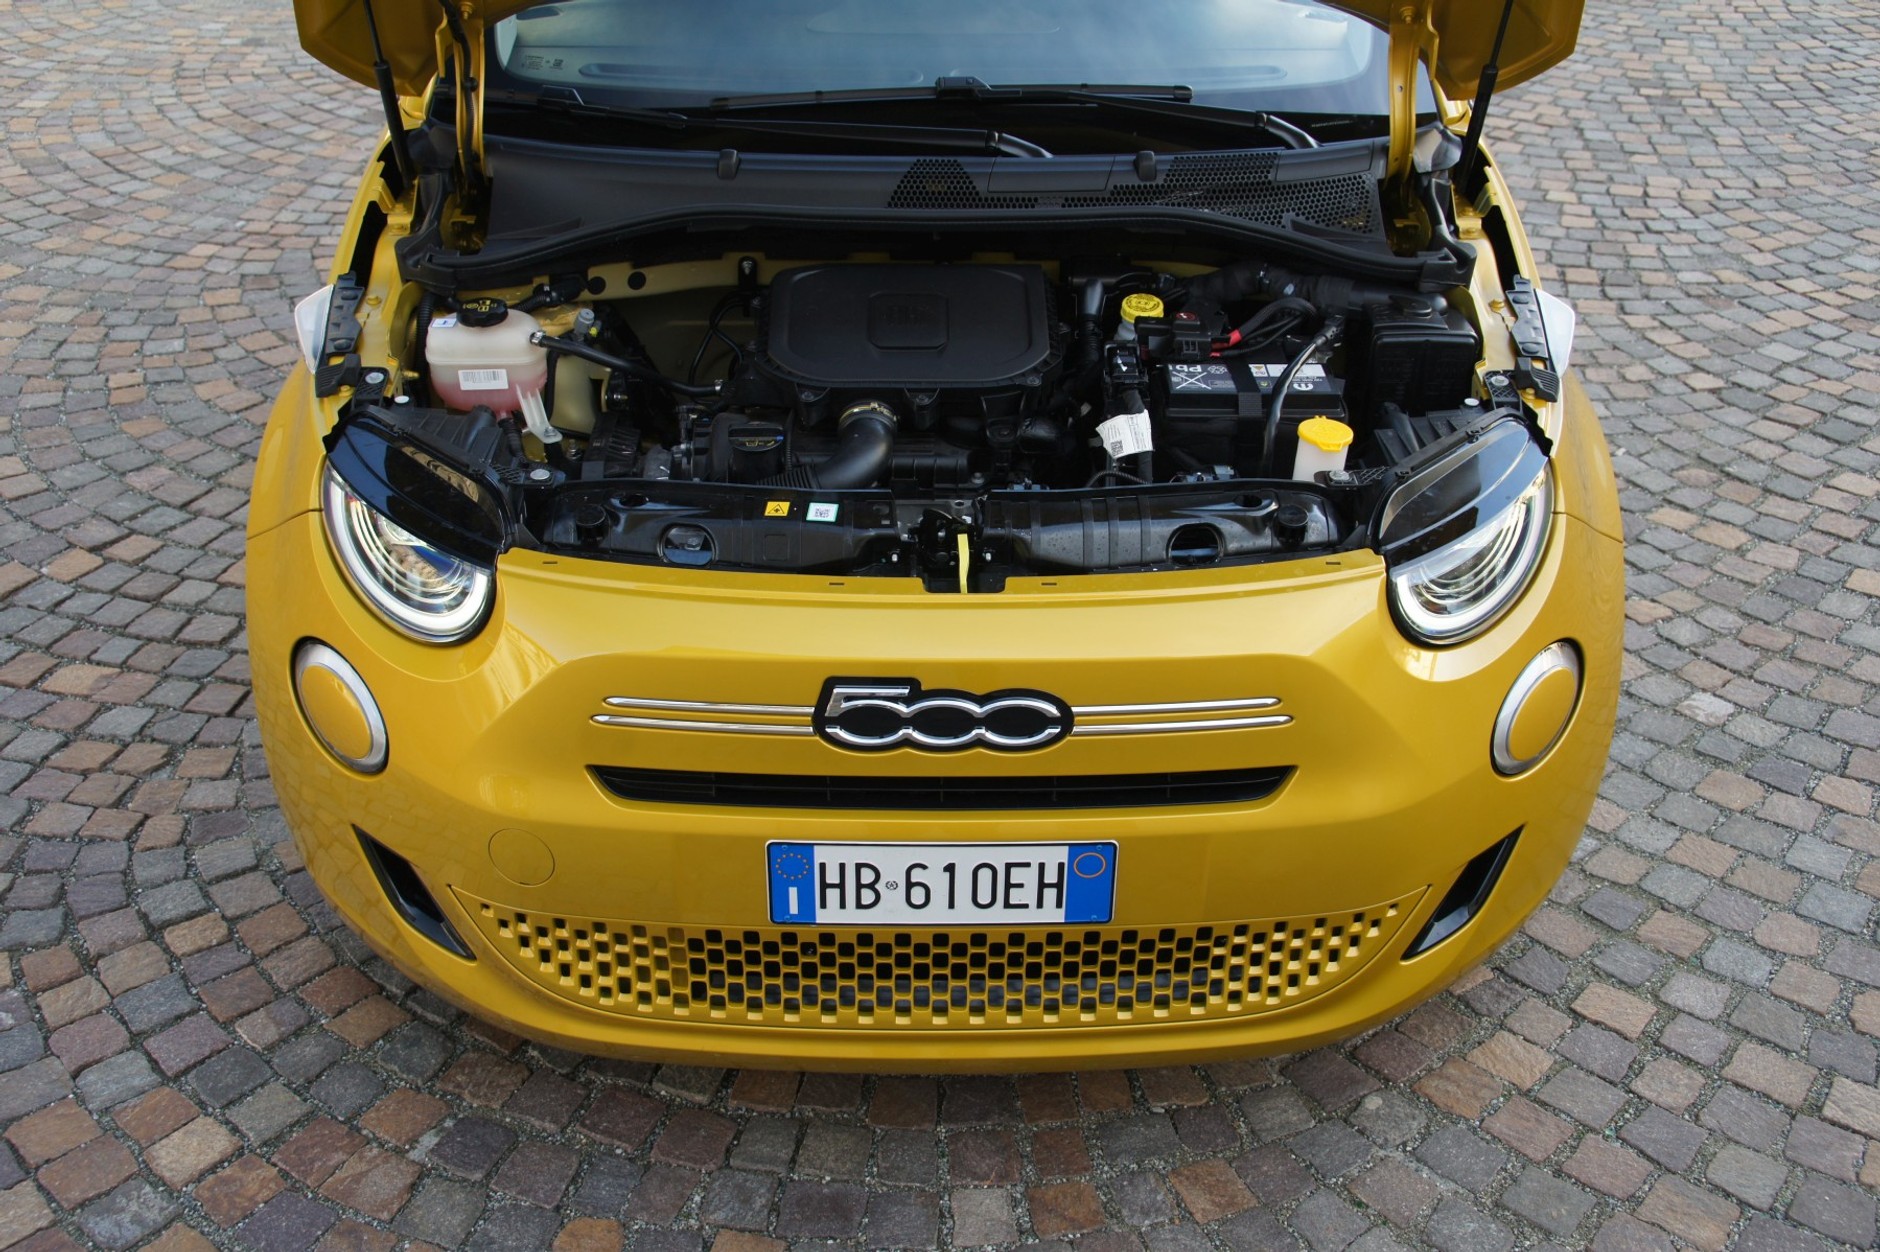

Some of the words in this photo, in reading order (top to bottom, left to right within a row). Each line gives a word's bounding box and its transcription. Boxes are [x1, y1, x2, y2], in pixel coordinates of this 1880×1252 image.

[824, 685, 1062, 747] 500
[788, 886, 799, 915] I
[818, 861, 882, 910] HB
[904, 861, 1066, 910] 610EH
